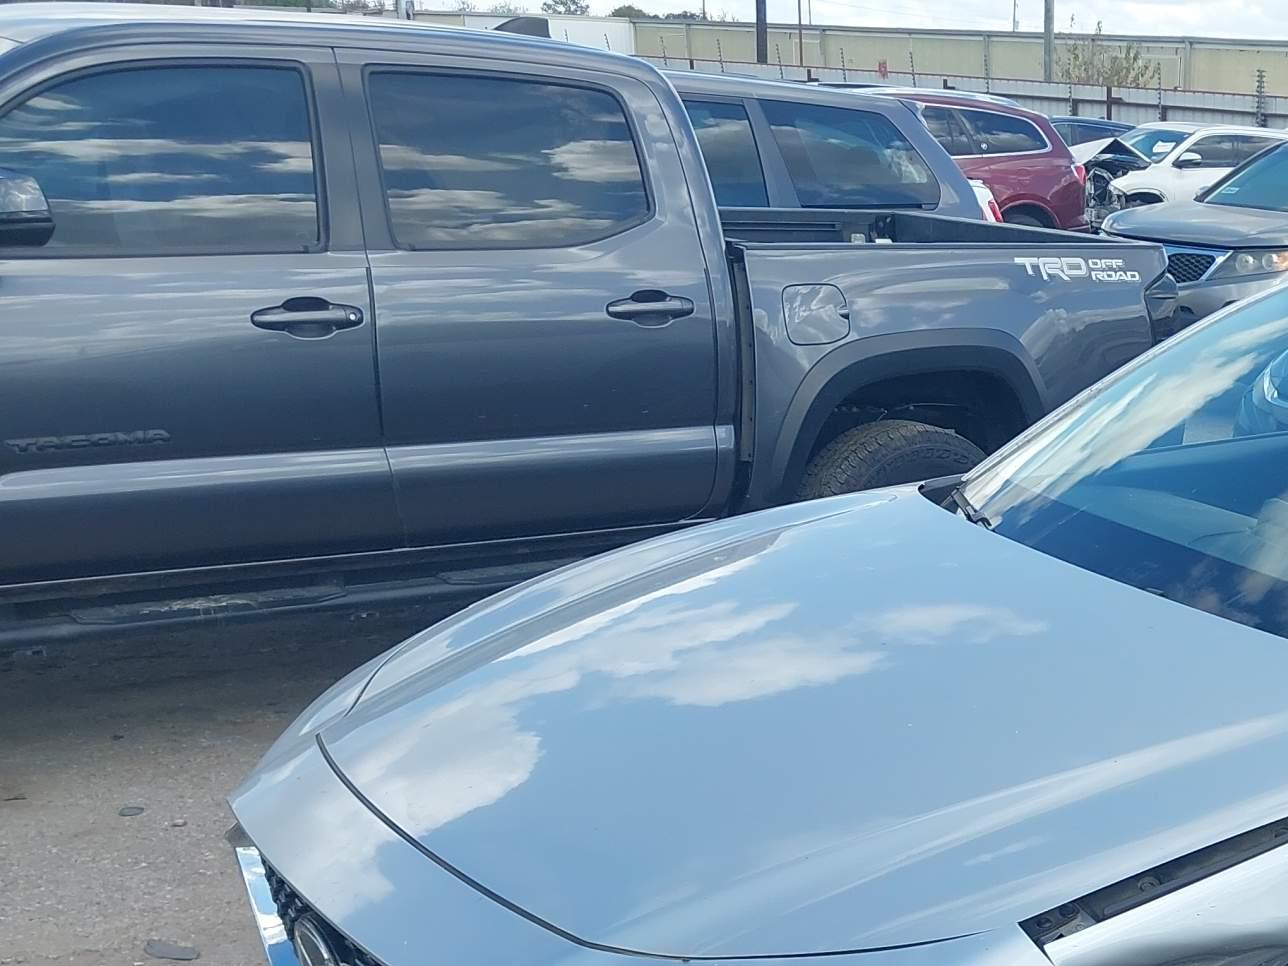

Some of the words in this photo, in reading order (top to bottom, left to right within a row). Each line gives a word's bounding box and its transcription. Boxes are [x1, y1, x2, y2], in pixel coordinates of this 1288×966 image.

[1014, 257, 1089, 282] TRD
[1088, 259, 1124, 269] OFF
[1091, 271, 1141, 282] ROAD
[5, 429, 171, 454] TACOMA
